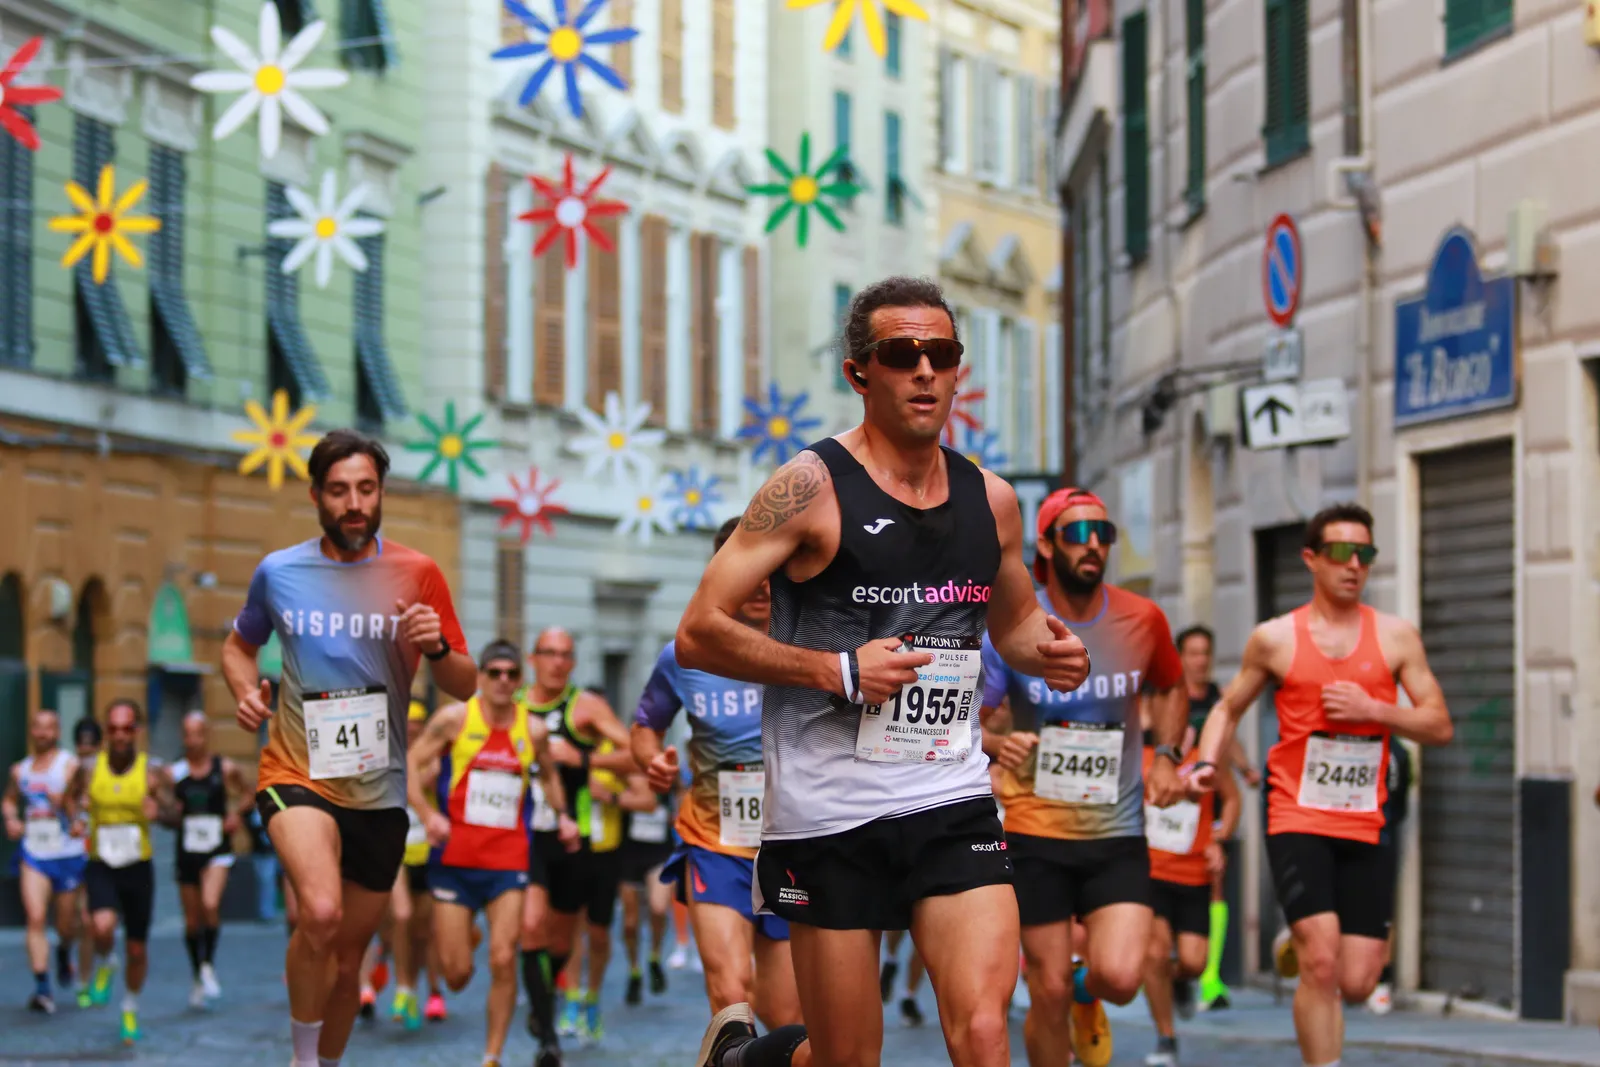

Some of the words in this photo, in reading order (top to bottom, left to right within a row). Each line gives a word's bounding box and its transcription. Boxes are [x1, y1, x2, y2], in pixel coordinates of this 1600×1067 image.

[914, 635, 961, 648] MYRUN.IT
[940, 653, 969, 661] PULSEE
[889, 685, 959, 725] 1955
[336, 723, 360, 748] 41
[885, 724, 909, 734] ANELLI
[910, 727, 943, 736] FRANCESCO
[1051, 753, 1108, 778] 2449
[1317, 761, 1369, 787] 2448
